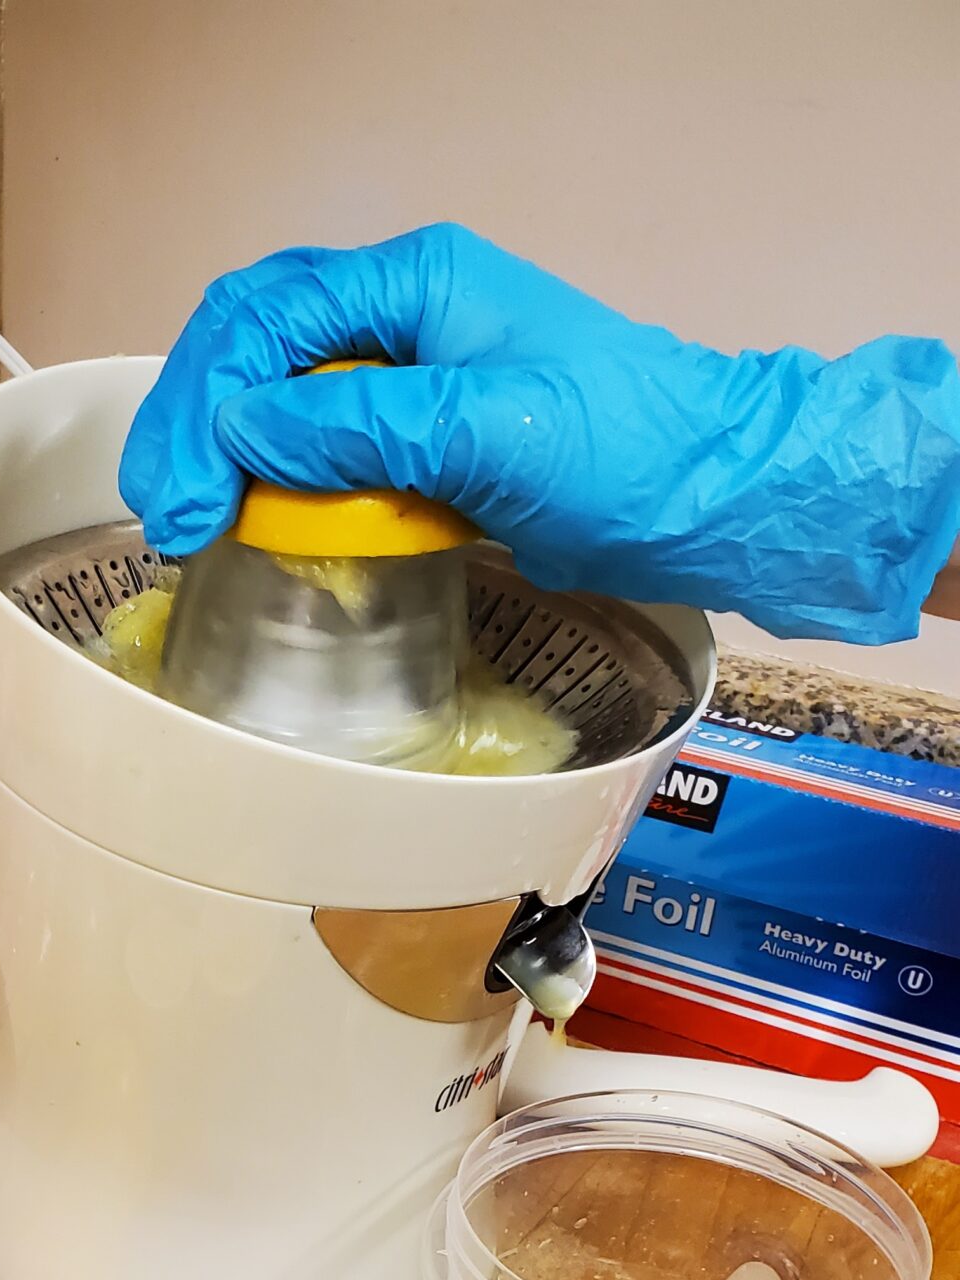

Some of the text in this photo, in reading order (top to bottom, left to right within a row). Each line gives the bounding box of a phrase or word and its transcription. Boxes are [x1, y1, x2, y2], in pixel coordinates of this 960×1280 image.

[623, 875, 716, 936] Foil
[759, 940, 872, 983] Aluminum Foil
[763, 922, 888, 971] Heavy Duty
